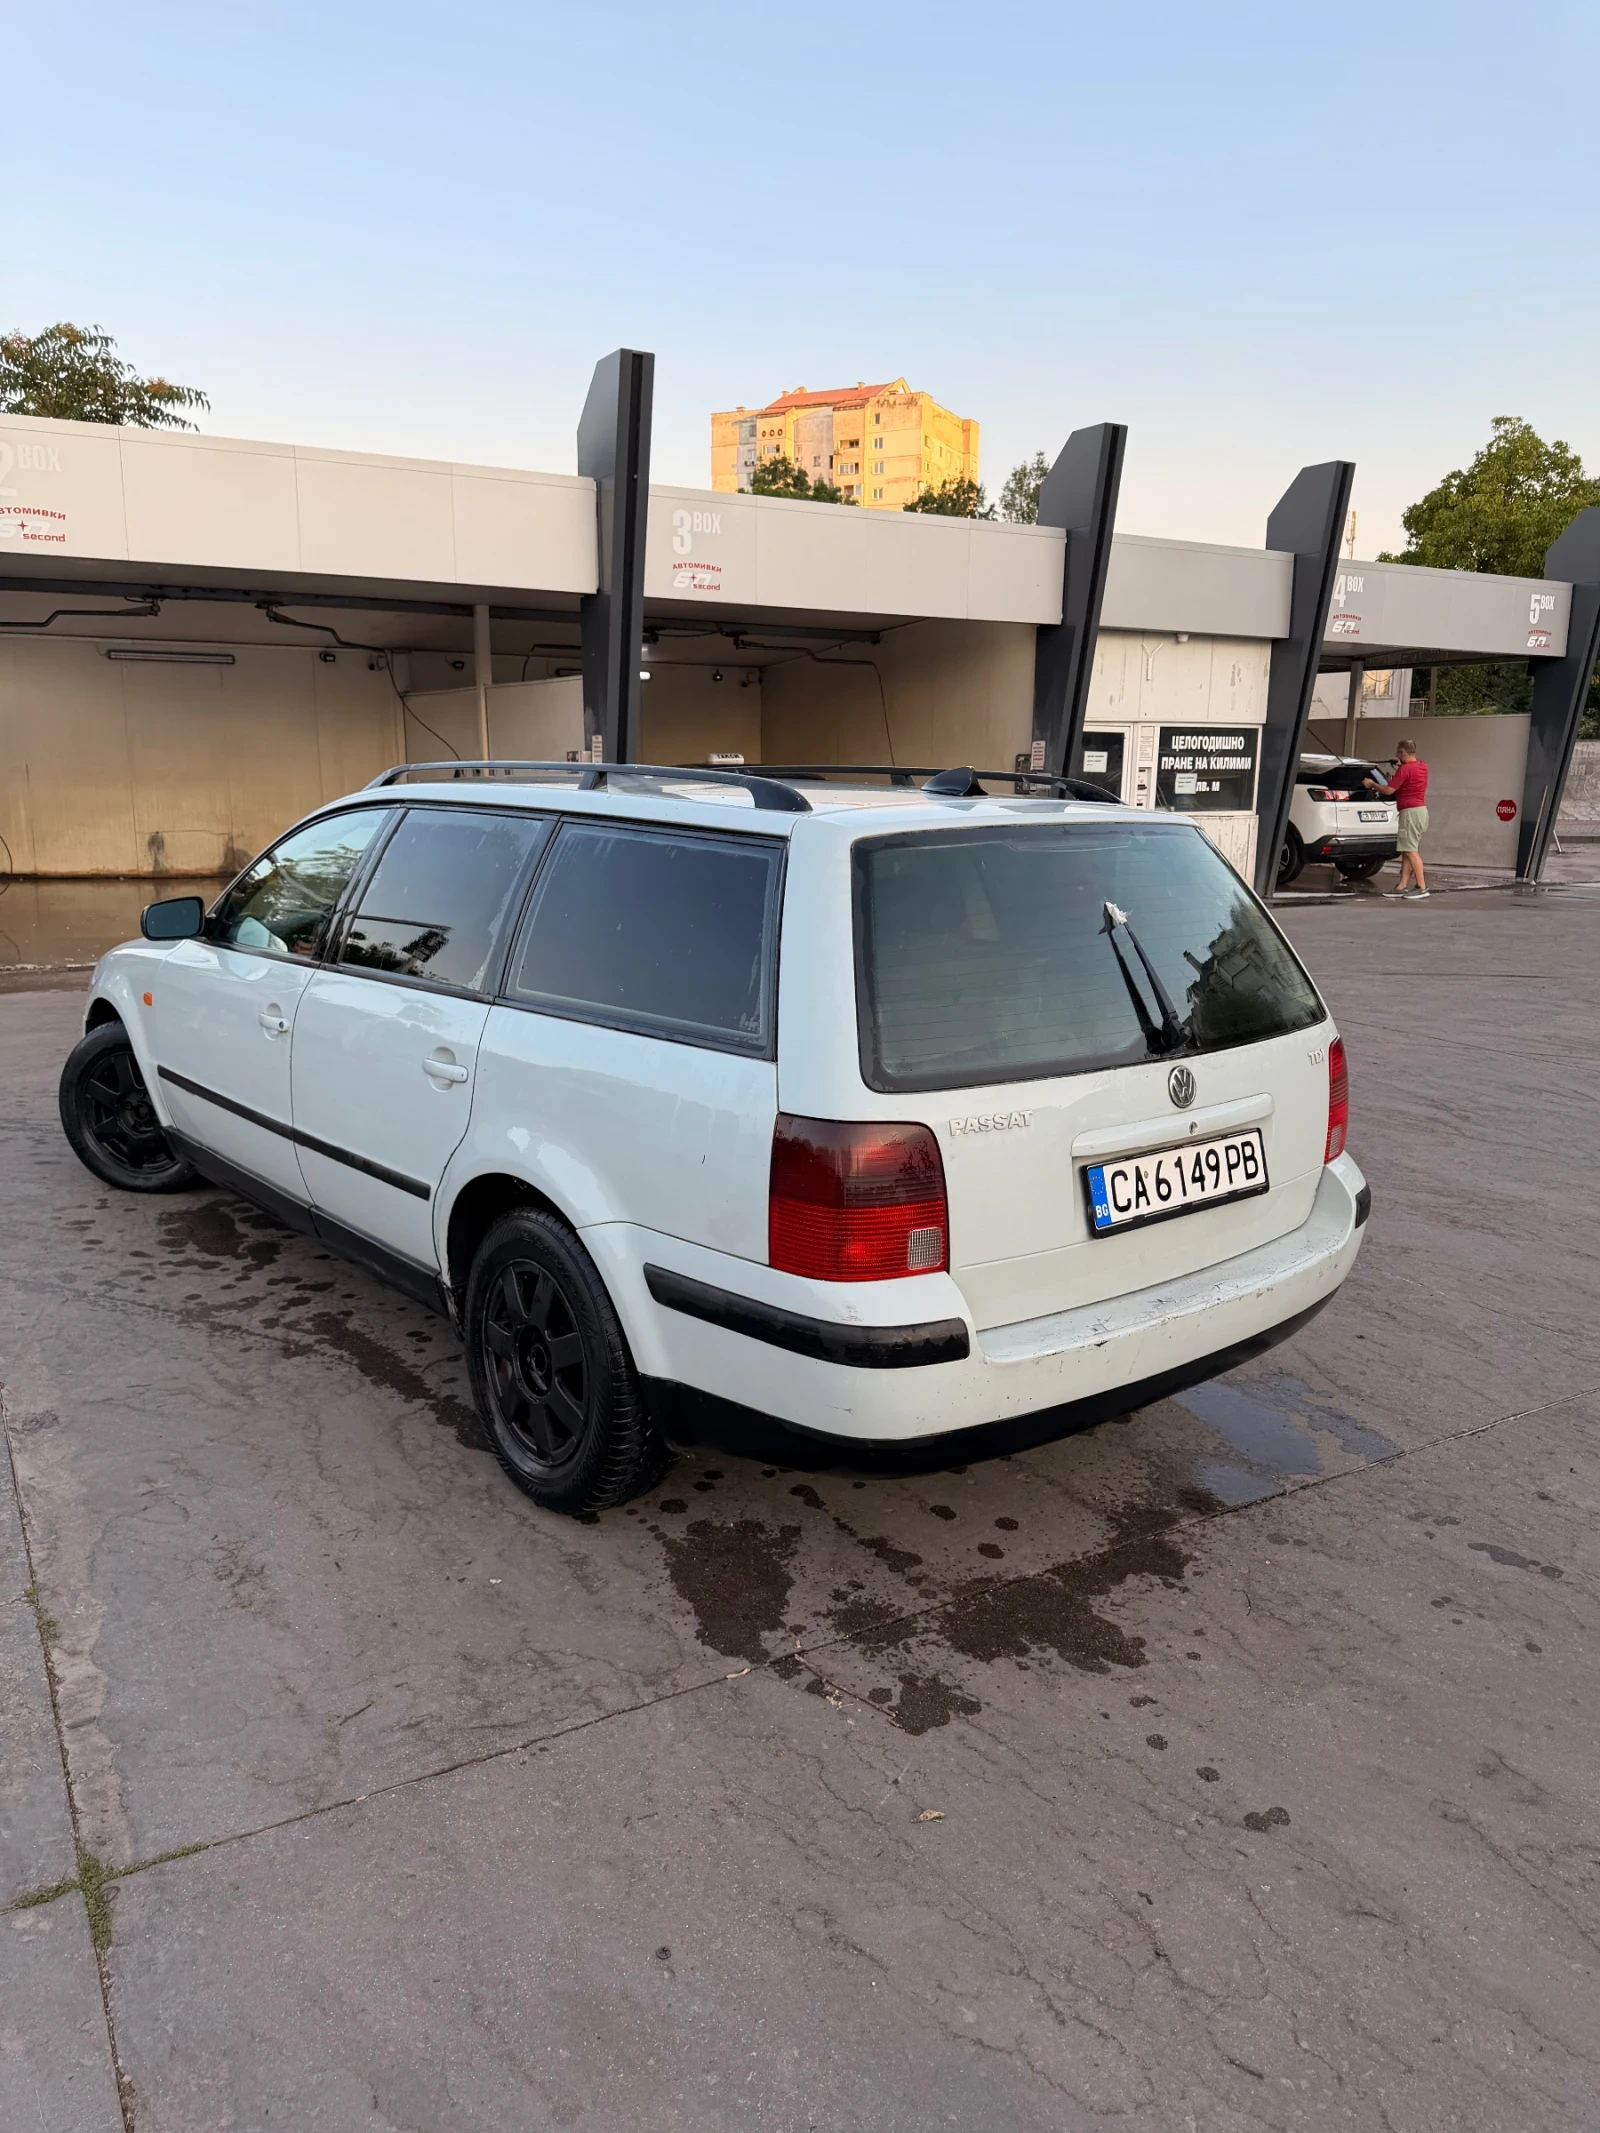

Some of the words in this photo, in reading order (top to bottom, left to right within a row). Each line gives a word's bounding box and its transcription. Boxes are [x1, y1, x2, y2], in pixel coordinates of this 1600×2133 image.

[0, 440, 18, 497] 2
[17, 443, 62, 472] BOX
[0, 506, 66, 521] ВТОМИВКИ
[22, 533, 66, 543] second
[672, 509, 692, 555] 3
[693, 511, 721, 534] BOX
[672, 562, 722, 573] АВТОМИВКИ
[1333, 575, 1347, 608] 4
[1347, 576, 1364, 592] BOX
[1529, 594, 1541, 625] 5
[1540, 595, 1555, 610] BOX
[1171, 735, 1245, 752] ЦЕЛОГОДИШНО
[1161, 757, 1193, 770] ПРАНЕ
[1195, 757, 1208, 770] НА
[1210, 757, 1252, 770] КИЛИМИ
[1497, 806, 1516, 814] ПЯНА
[1307, 1048, 1325, 1066] TDI
[949, 1109, 1034, 1137] PASSAT
[1095, 1203, 1109, 1219] BG
